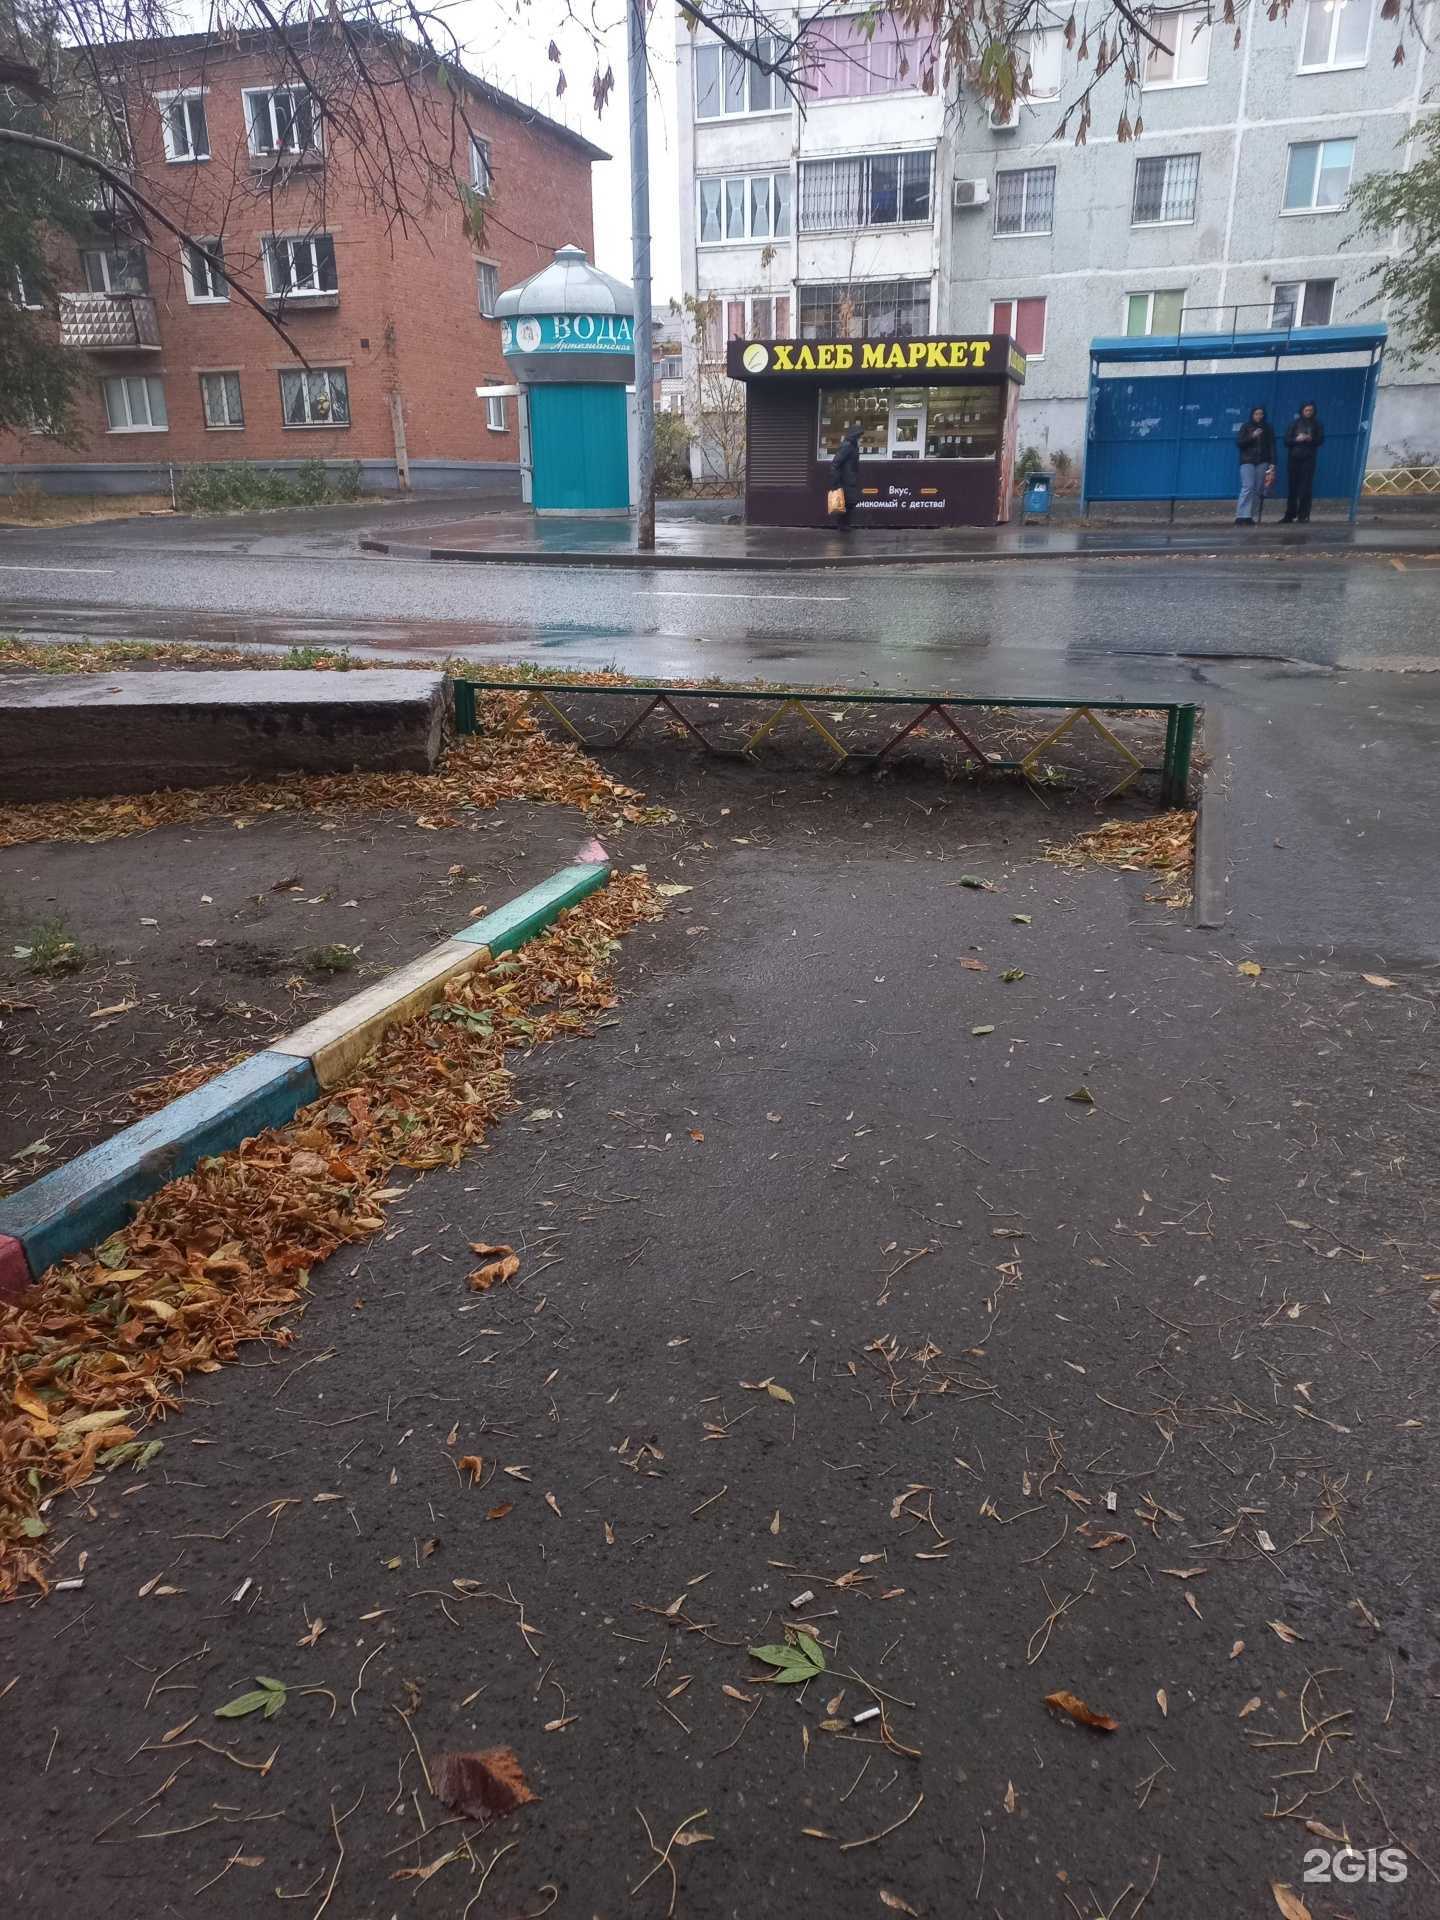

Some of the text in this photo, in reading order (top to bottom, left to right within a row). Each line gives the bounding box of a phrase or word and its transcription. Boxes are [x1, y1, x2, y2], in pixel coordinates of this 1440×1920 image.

[553, 314, 631, 344] ВОДА
[772, 344, 853, 370] ХЛЕБ
[861, 341, 990, 368] МАРКЕТ
[888, 485, 912, 497] Вкус,
[909, 499, 946, 509] детства!
